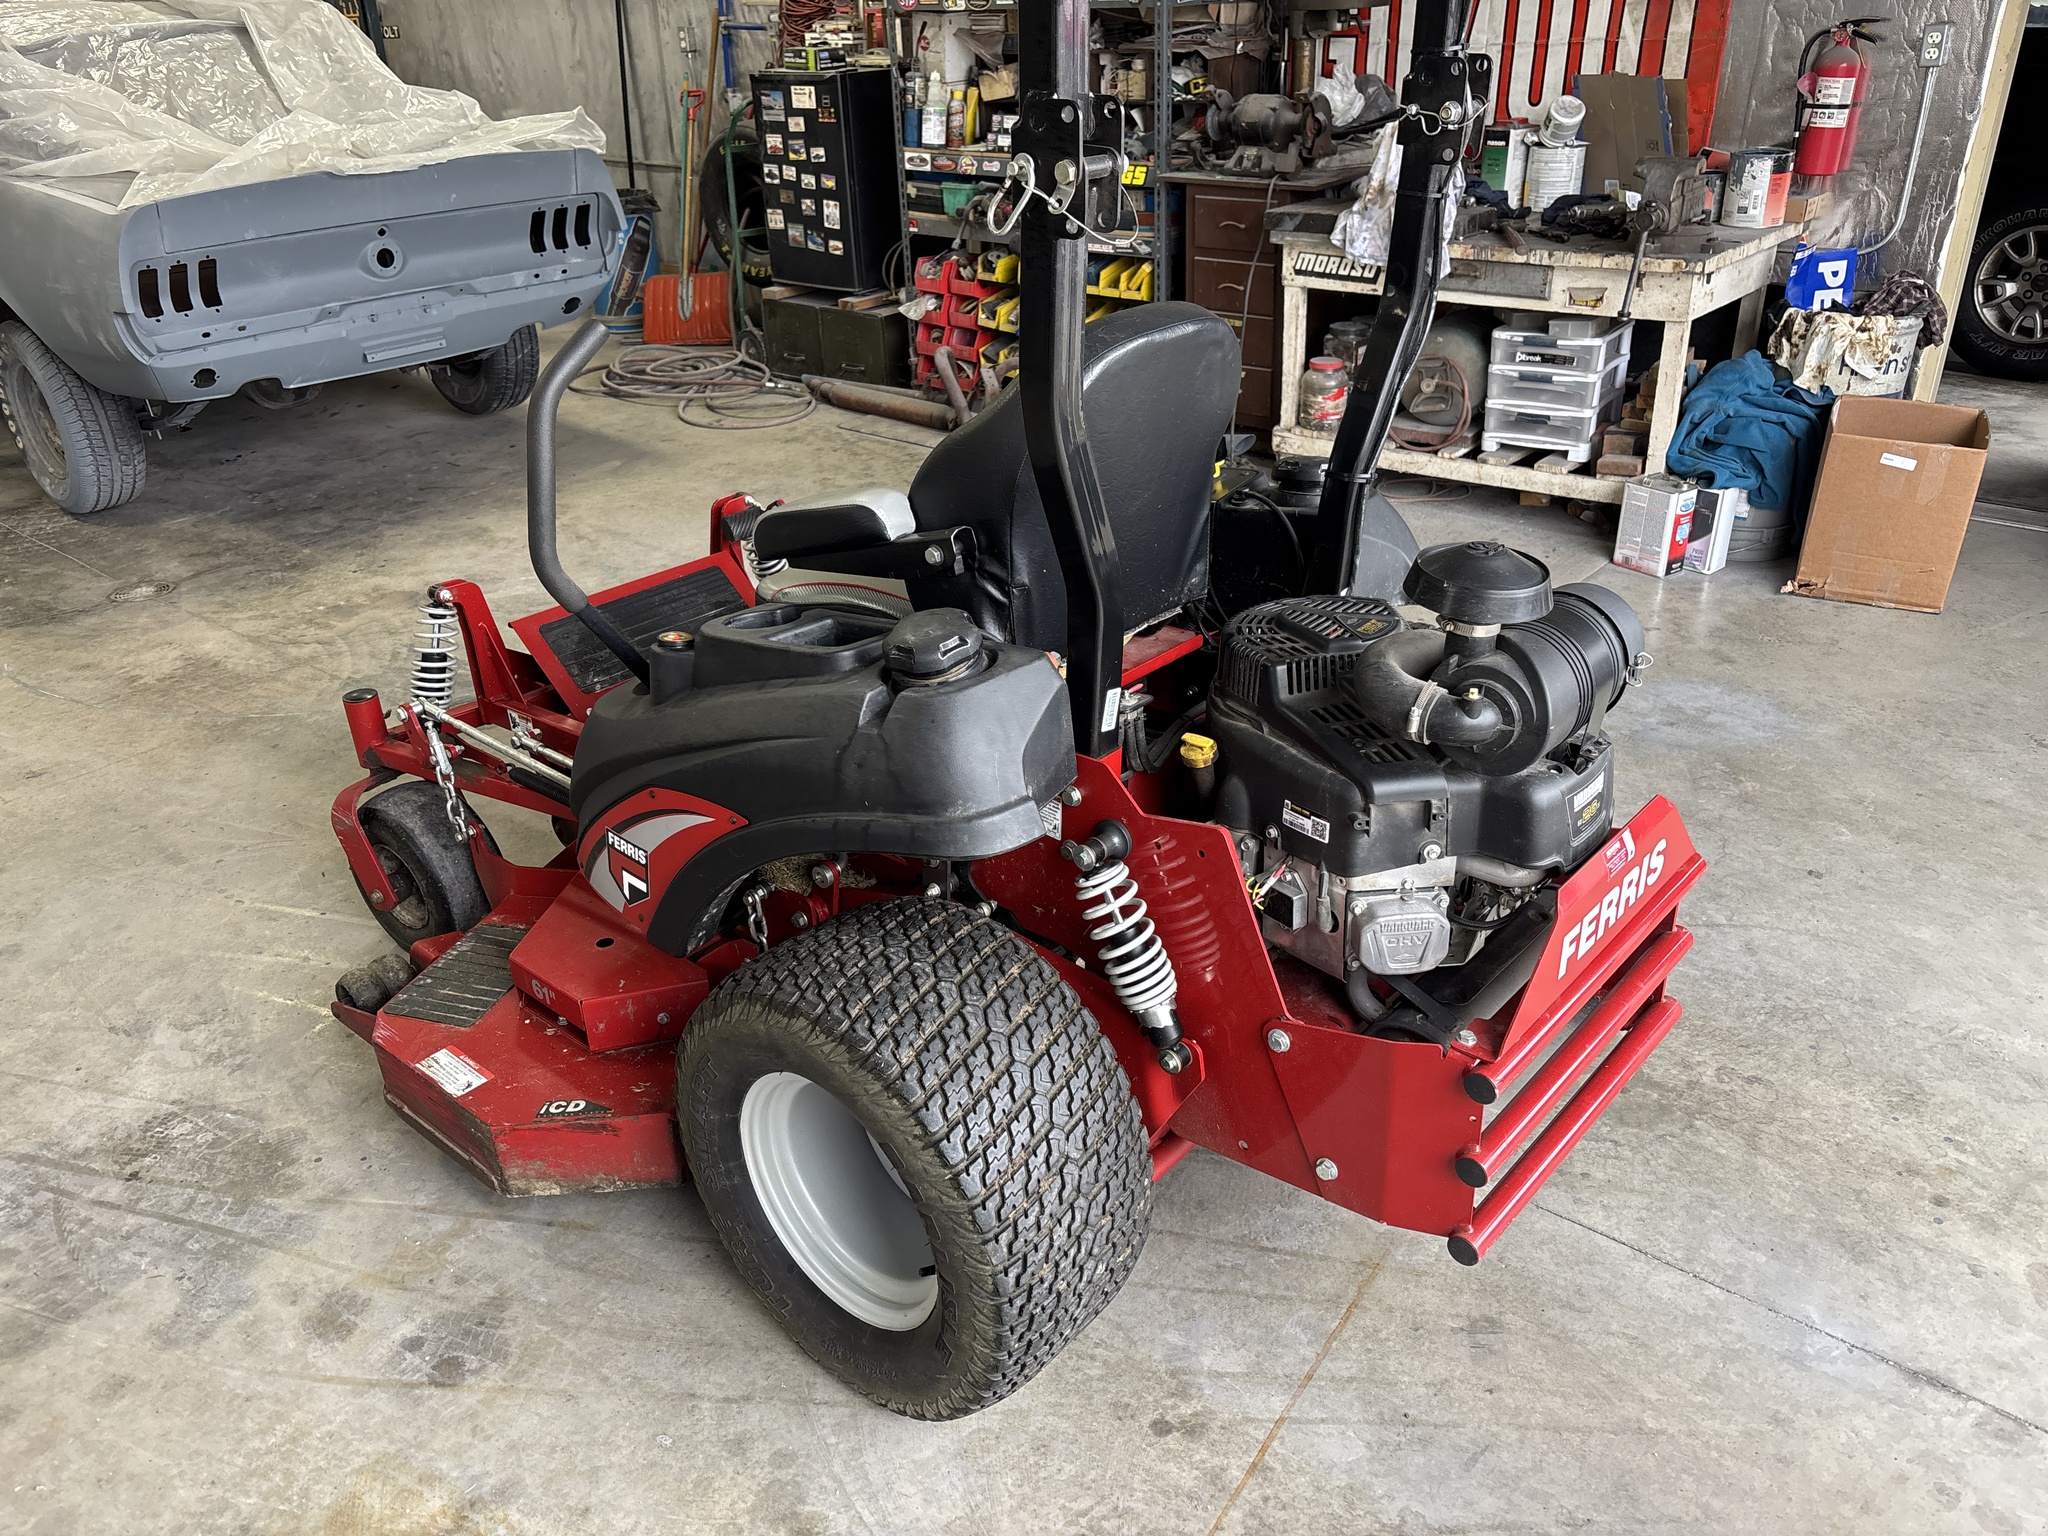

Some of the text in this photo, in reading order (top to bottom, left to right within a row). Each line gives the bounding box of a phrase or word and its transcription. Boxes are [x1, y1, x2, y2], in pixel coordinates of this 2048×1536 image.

[1294, 252, 1378, 279] MOROSO
[607, 831, 647, 865] FERRIS
[1557, 838, 1668, 981] FERRIS
[1385, 934, 1428, 947] OHV
[687, 1052, 719, 1192] SMART
